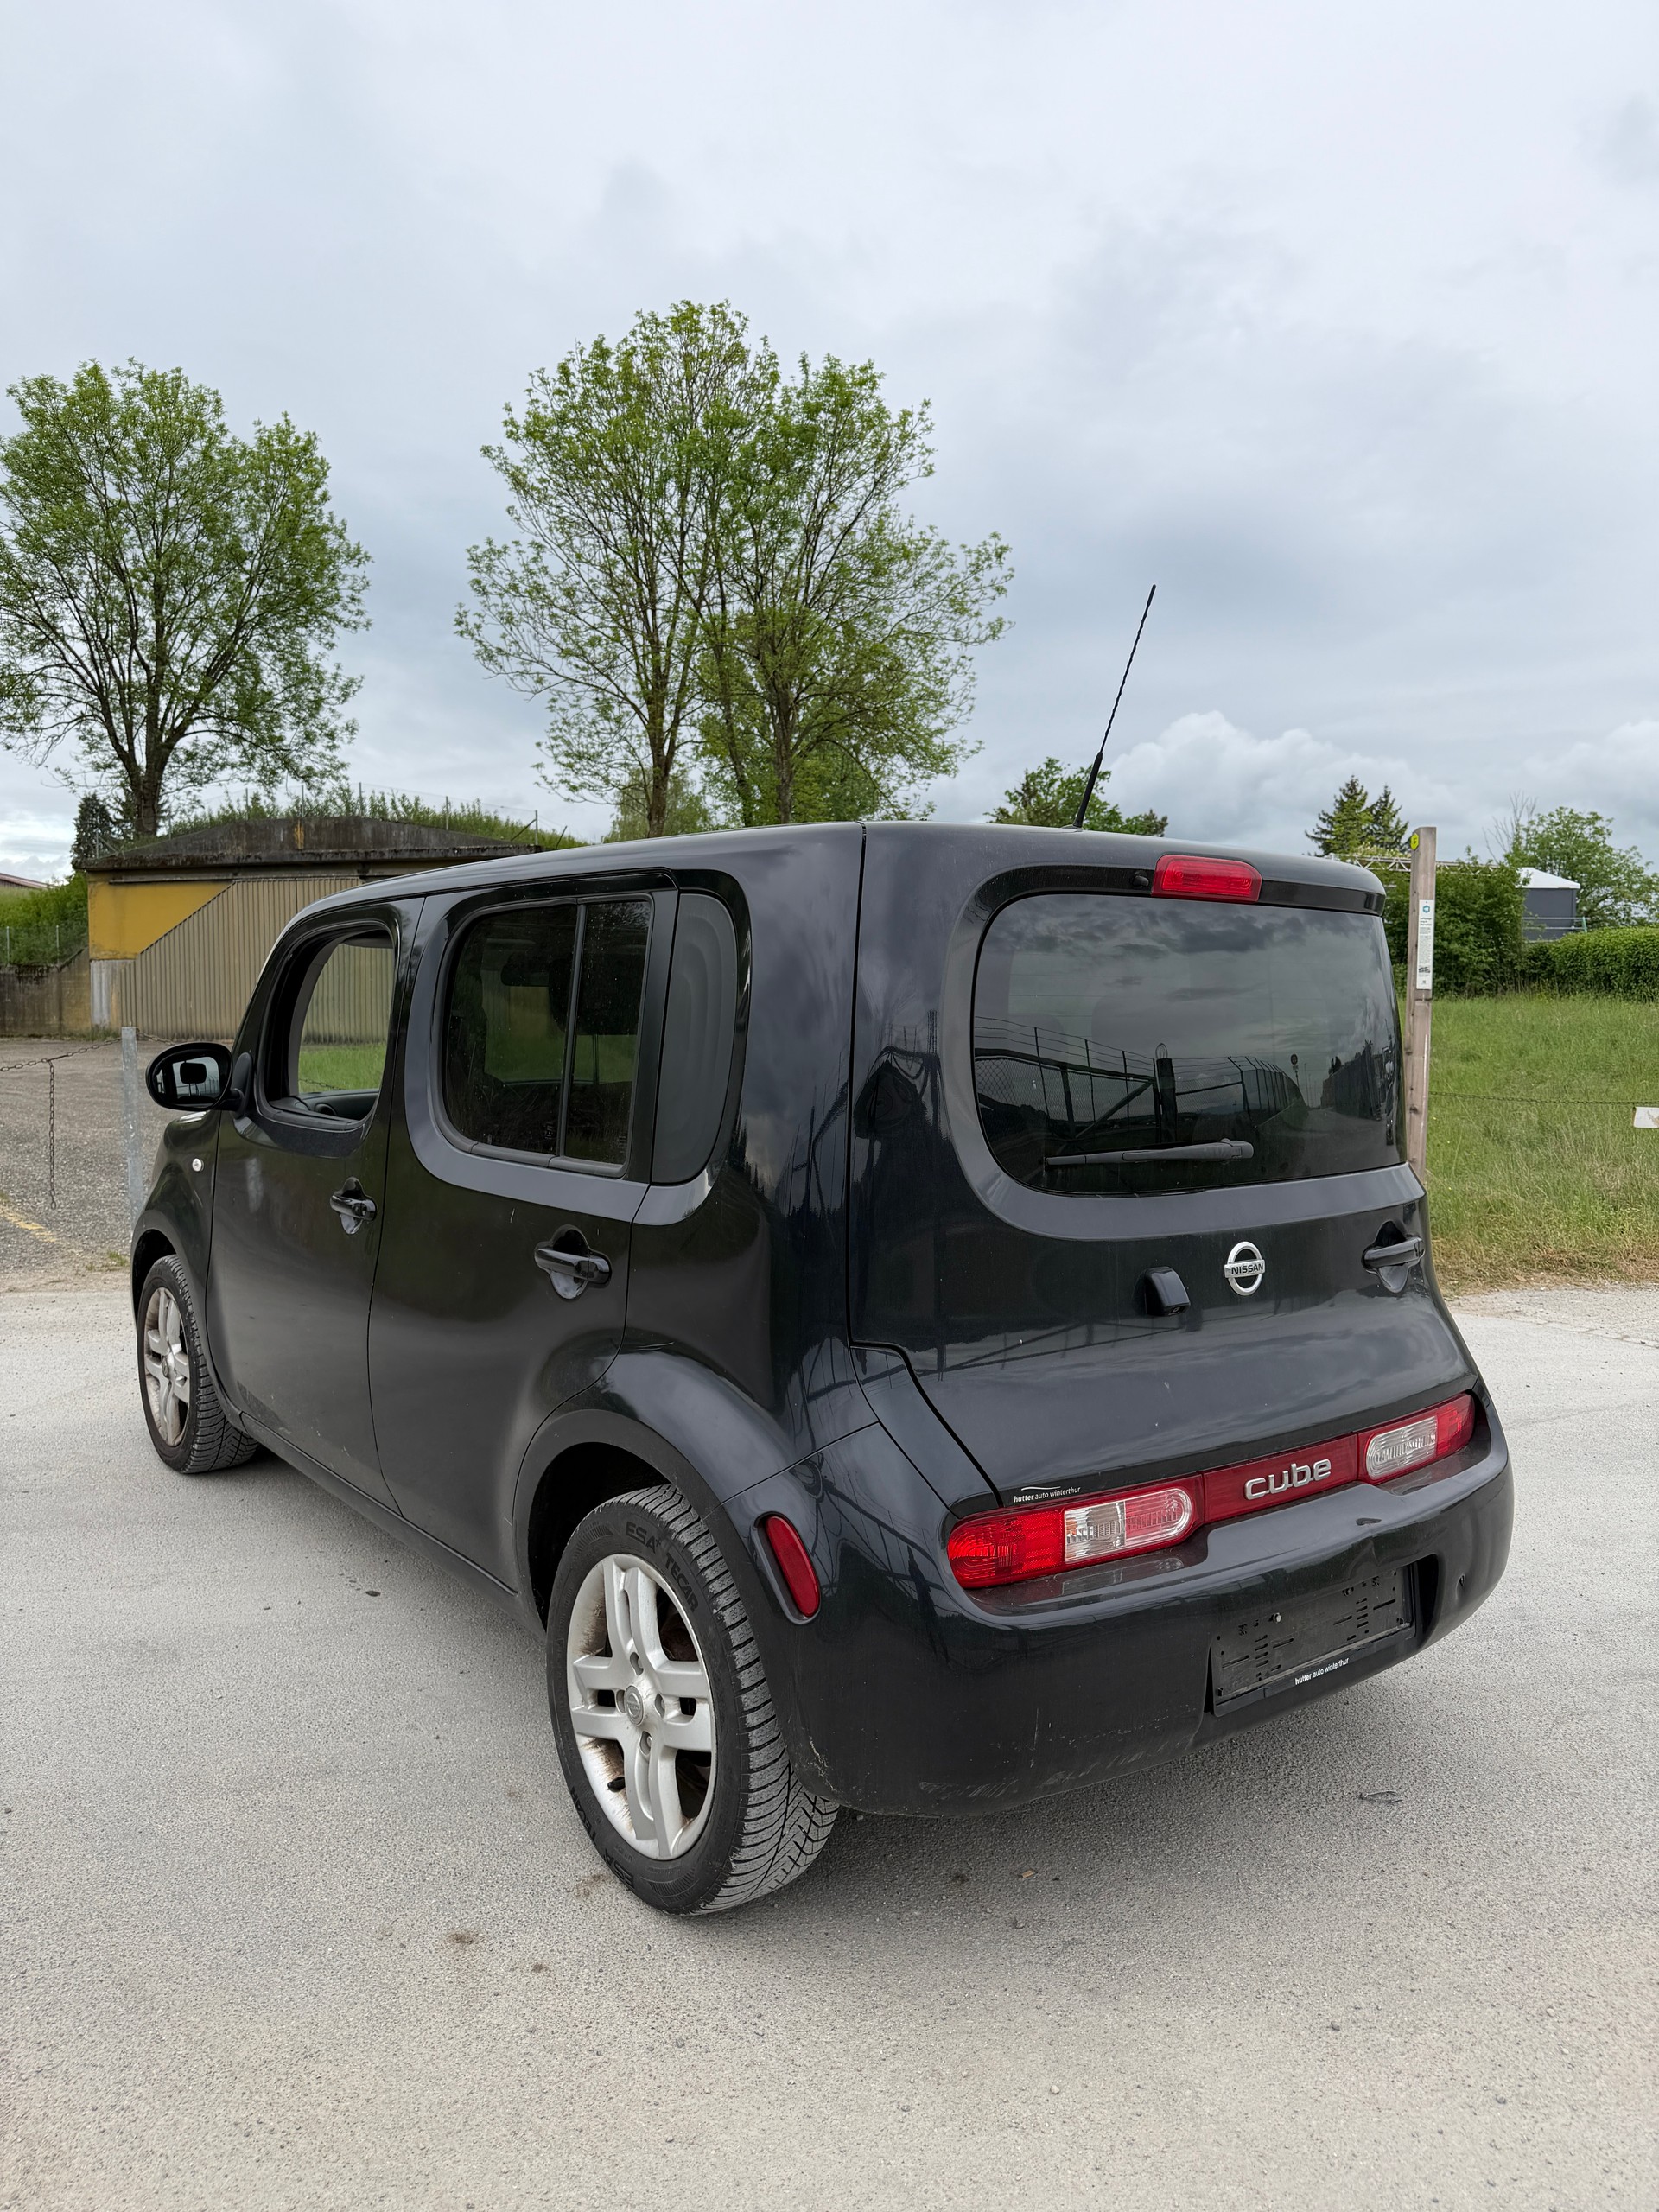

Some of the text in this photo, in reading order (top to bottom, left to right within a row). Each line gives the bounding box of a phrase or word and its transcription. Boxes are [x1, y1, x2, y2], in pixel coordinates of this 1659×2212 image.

[1231, 1263, 1264, 1274] NISSAN
[1245, 1459, 1332, 1500] cube
[1014, 1486, 1081, 1503] hutter auto winterthur
[665, 1552, 698, 1612] TECAR
[1294, 1657, 1350, 1685] hutter auto winterthur
